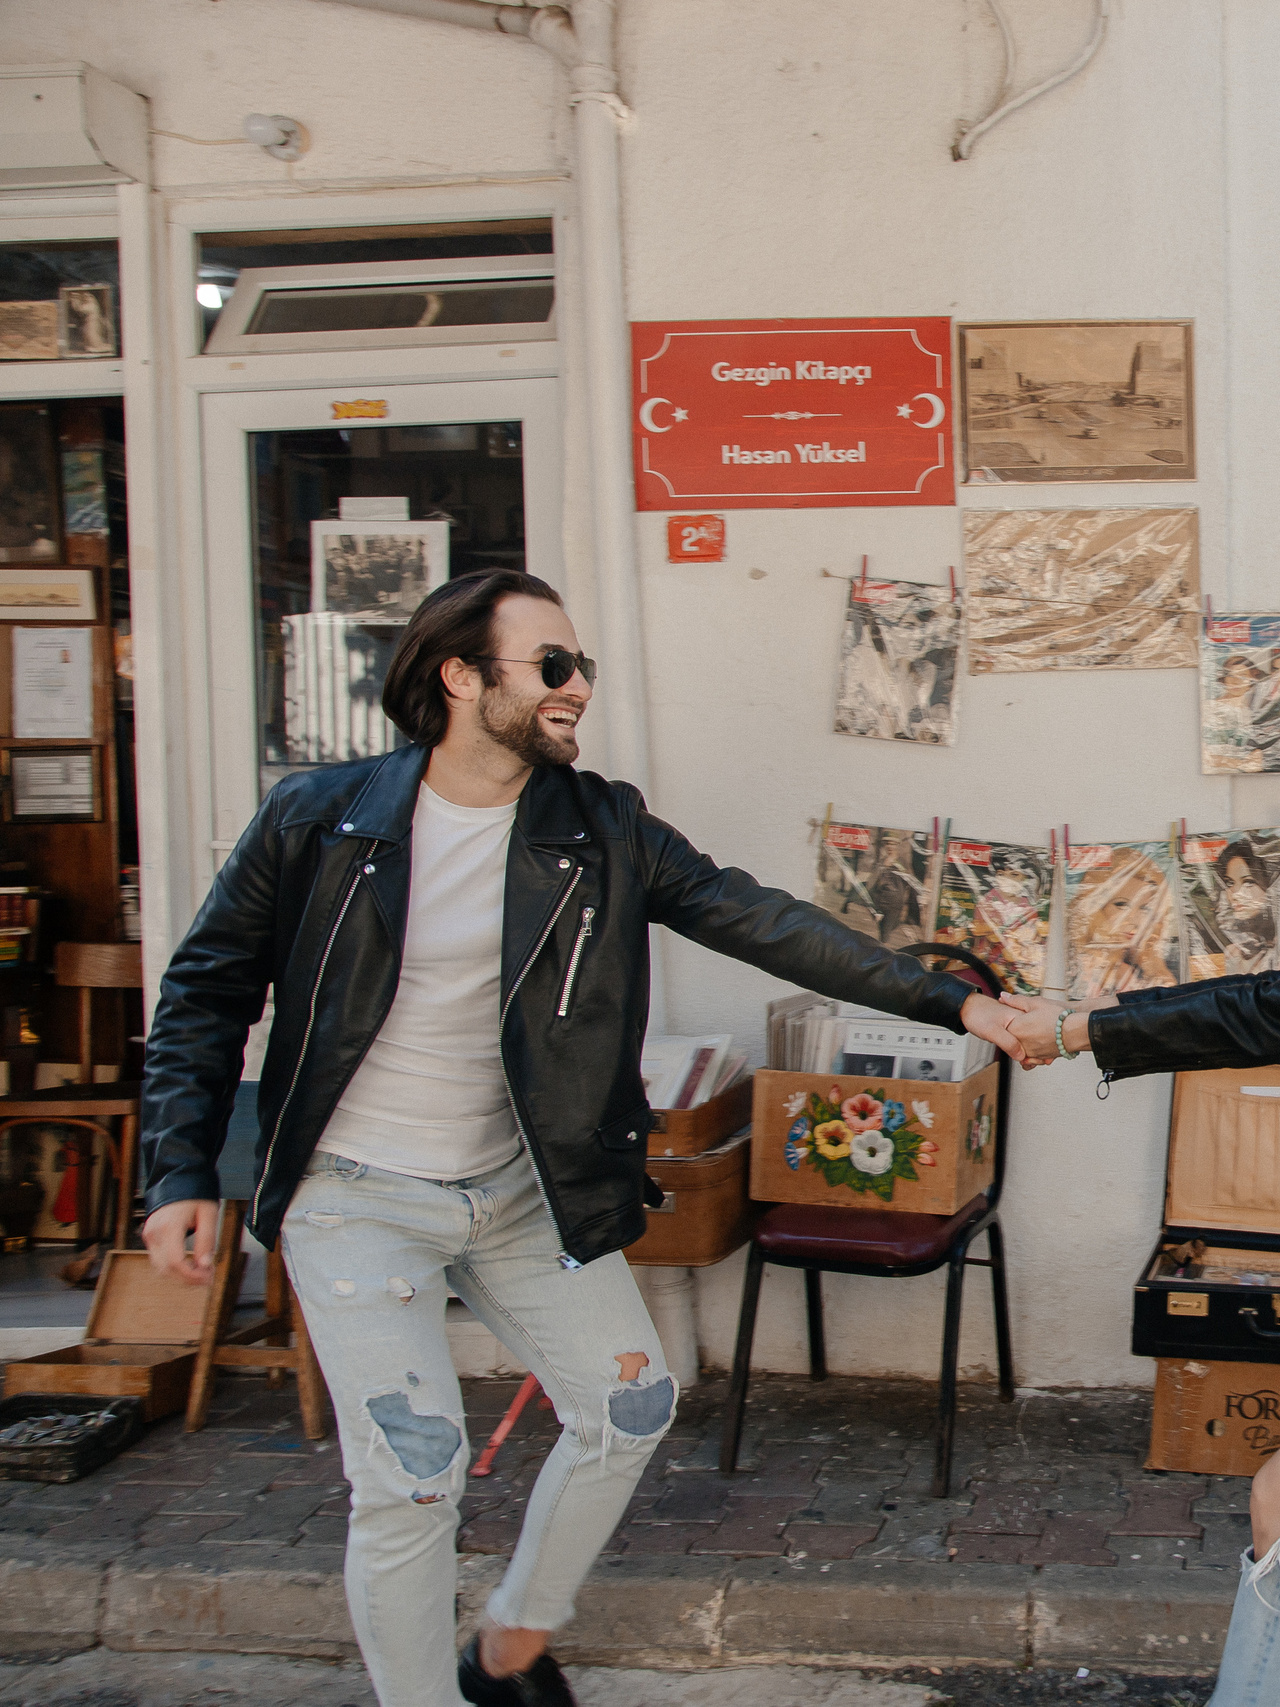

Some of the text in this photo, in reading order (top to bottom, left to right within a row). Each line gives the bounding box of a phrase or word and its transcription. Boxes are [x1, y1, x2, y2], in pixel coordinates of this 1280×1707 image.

[711, 360, 872, 386] Gezgin Kitapçı
[721, 441, 866, 464] Hasan Yüksel
